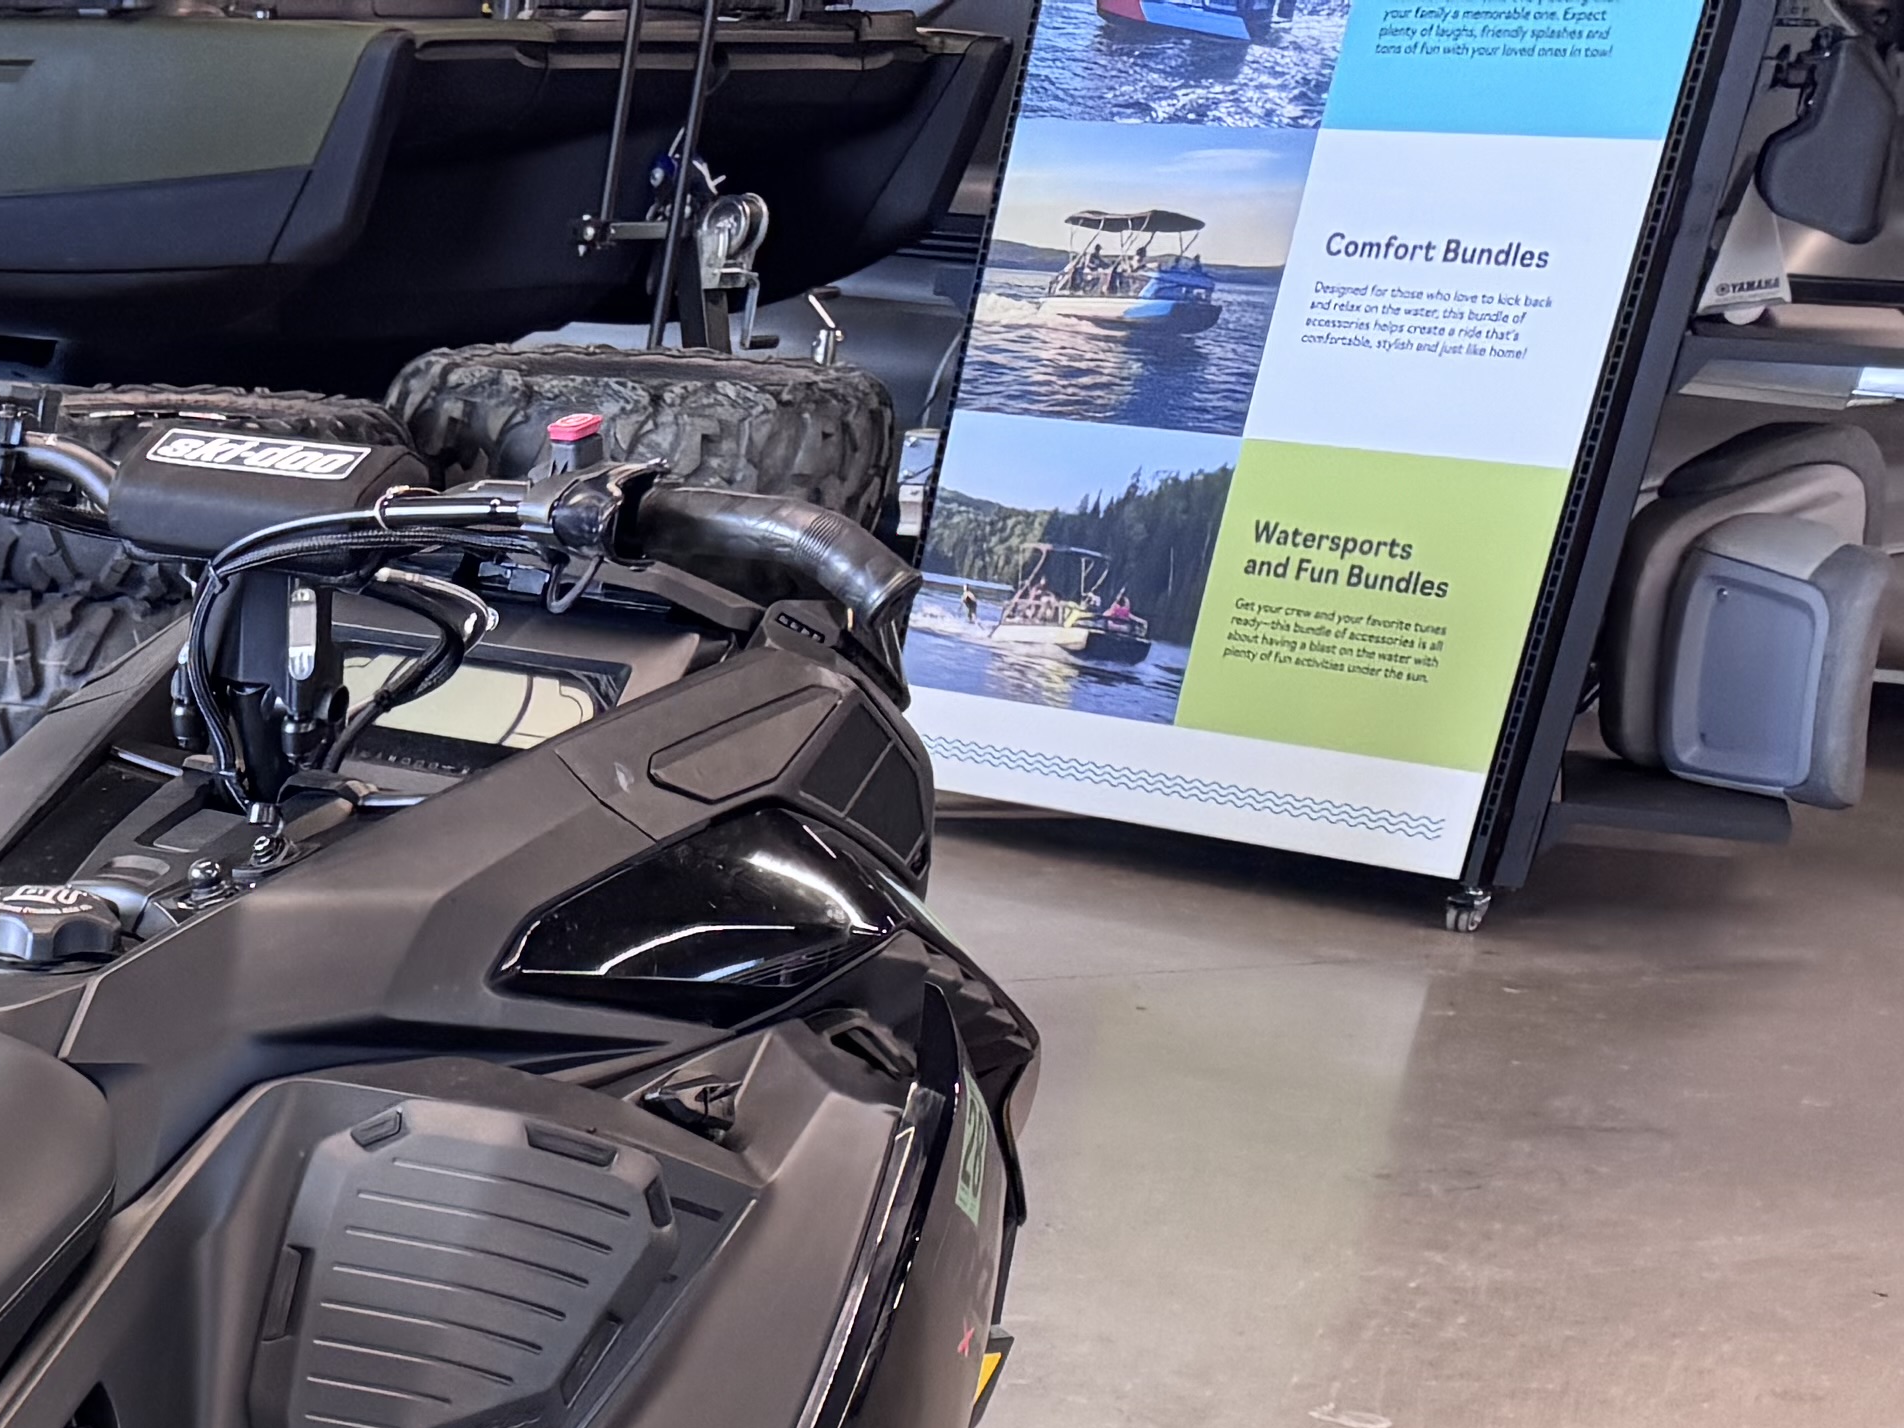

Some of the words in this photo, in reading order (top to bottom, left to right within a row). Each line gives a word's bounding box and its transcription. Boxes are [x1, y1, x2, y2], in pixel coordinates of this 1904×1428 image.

[1384, 9, 1409, 20] your
[1414, 7, 1449, 22] family
[1452, 10, 1460, 20] a
[1463, 8, 1531, 20] memorable
[1534, 10, 1560, 21] one.
[1563, 8, 1607, 23] Expect
[1378, 24, 1416, 39] plenty
[1420, 24, 1434, 38] of
[1436, 24, 1477, 41] laughs,
[1480, 25, 1528, 41] friendly
[1531, 25, 1583, 41] splashes
[1586, 26, 1611, 40] and
[1376, 43, 1401, 55] tons
[1404, 43, 1418, 56] of
[1420, 42, 1440, 56] fun
[1443, 44, 1469, 56] with
[1471, 46, 1500, 59] your
[1502, 44, 1534, 57] loved
[1538, 46, 1567, 57] ones
[1570, 45, 1581, 57] in
[1584, 45, 1613, 58] tow!
[1325, 232, 1437, 262] Comfort
[1442, 239, 1549, 268] Bundles
[1315, 281, 1368, 297] Designed
[1371, 285, 1388, 297] for
[1390, 287, 1423, 299] those
[1426, 288, 1450, 301] who
[1454, 291, 1478, 304] love
[1481, 294, 1493, 305] to
[1498, 293, 1520, 306] kick
[1524, 295, 1552, 308] back
[1731, 277, 1780, 294] YAMAHA
[1310, 299, 1330, 311] and
[1334, 300, 1361, 312] relax
[1364, 304, 1379, 313] on
[1382, 303, 1401, 315] the
[1404, 307, 1438, 319] water,
[1443, 308, 1464, 320] this
[1468, 309, 1509, 323] bundle
[1512, 312, 1527, 324] of
[1306, 318, 1370, 331] accessories
[1373, 319, 1404, 335] helps
[1407, 324, 1445, 336] create
[1448, 327, 1455, 337] a
[1458, 326, 1482, 339] ride
[1485, 328, 1519, 341] that's
[1301, 332, 1372, 350] comfortable,
[1376, 338, 1413, 352] stylish
[1416, 341, 1439, 353] and
[1439, 342, 1462, 357] just
[1466, 343, 1486, 356] like
[1489, 346, 1527, 360] home!
[155, 437, 356, 474] ski-doo
[1254, 519, 1414, 561] Watersports
[1244, 556, 1290, 578] and
[1295, 558, 1340, 585] Fun
[1346, 564, 1449, 598] Bundles
[1235, 598, 1255, 612] Get
[1257, 603, 1283, 615] your
[1285, 607, 1311, 618] crew
[1314, 609, 1336, 622] and
[1336, 613, 1364, 625] your
[1365, 615, 1411, 631] favorite
[1415, 624, 1447, 636] tunes
[1227, 630, 1259, 644] about
[1261, 634, 1297, 650] having
[1299, 641, 1306, 650] a
[1310, 641, 1336, 655] blast
[1339, 646, 1353, 657] on
[1356, 647, 1375, 660] the
[1378, 652, 1411, 665] water
[1414, 655, 1439, 668] with
[1293, 622, 1331, 637] bundle
[1334, 627, 1347, 640] of
[1348, 630, 1415, 649] accessories
[1418, 638, 1427, 650] is
[1430, 640, 1444, 651] all
[1223, 647, 1257, 662] plenty
[1260, 651, 1273, 662] of
[1273, 652, 1292, 664] fun
[1295, 655, 1345, 672] activities
[1347, 663, 1382, 677] under
[1384, 667, 1404, 681] the
[1406, 672, 1428, 683] sun.
